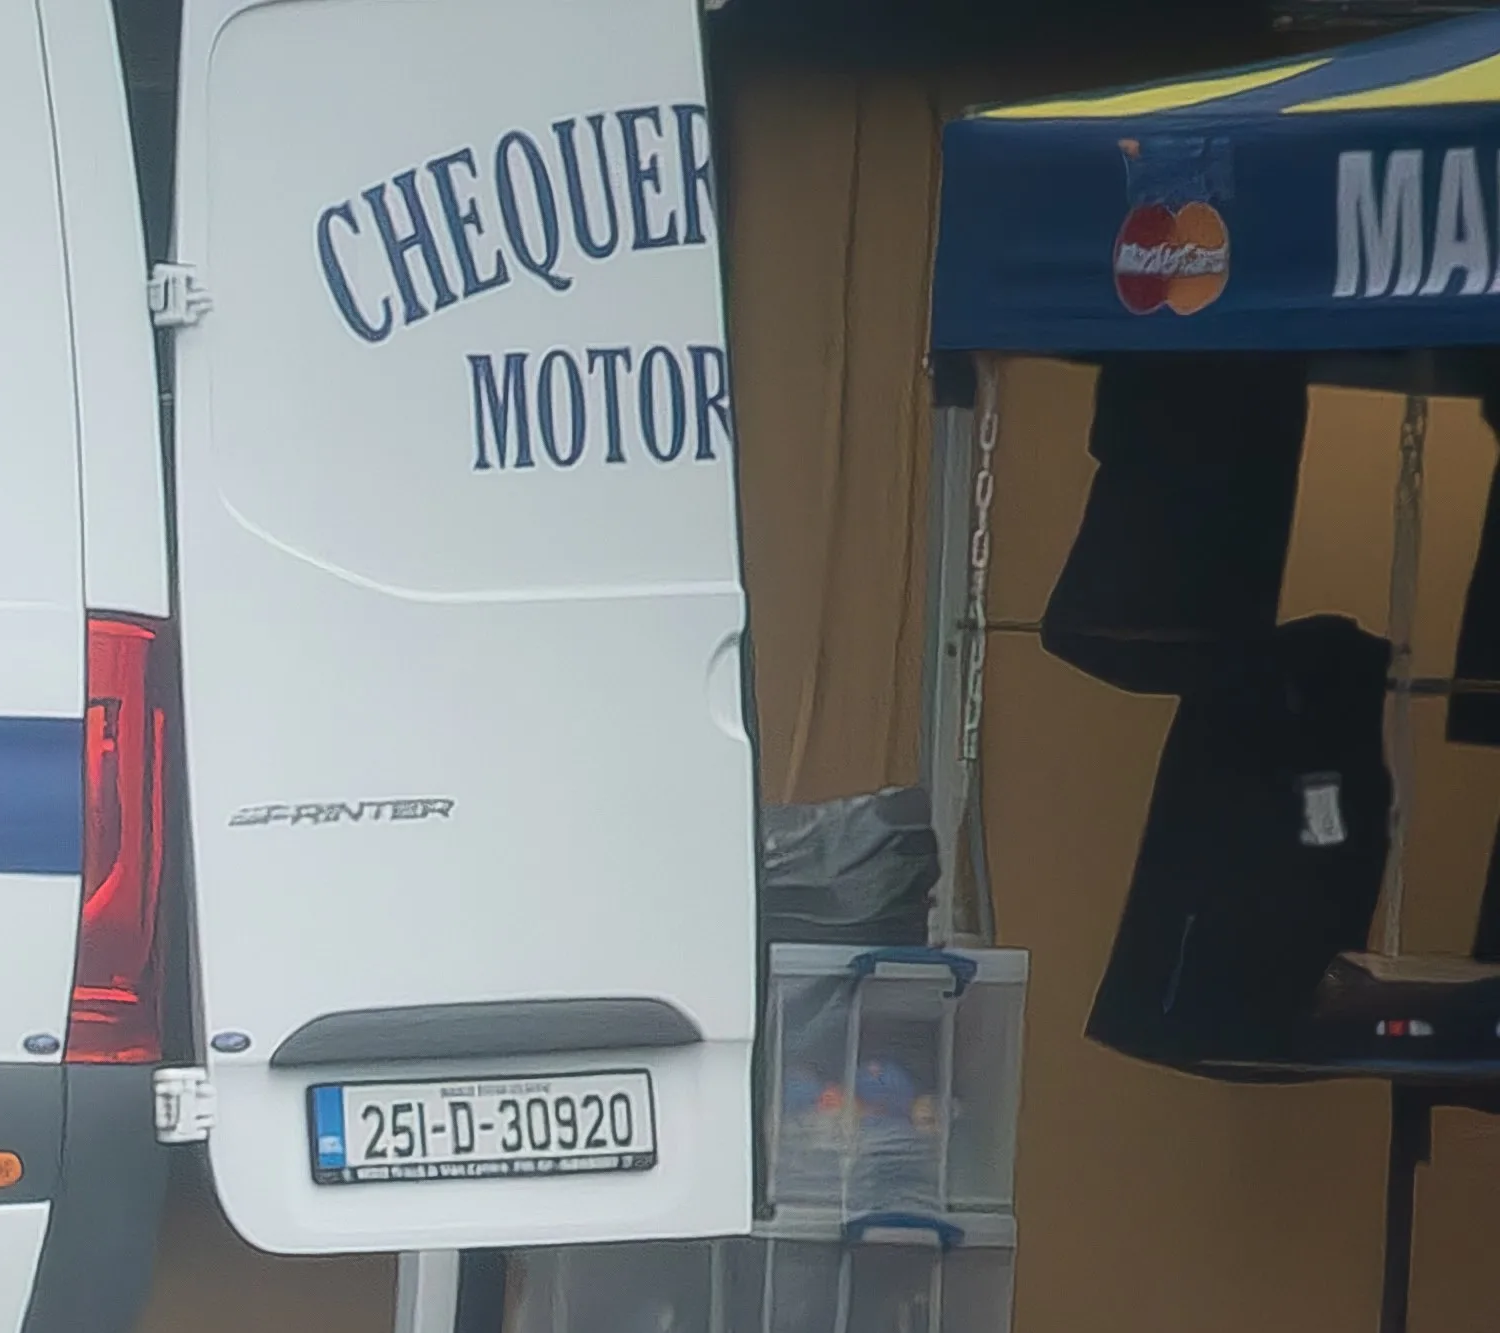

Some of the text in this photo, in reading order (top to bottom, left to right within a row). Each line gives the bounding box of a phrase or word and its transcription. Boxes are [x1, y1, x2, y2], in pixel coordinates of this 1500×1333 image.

[1332, 146, 1500, 299] MA
[466, 345, 732, 471] MOTOR
[361, 1092, 635, 1160] 251-D-30920
